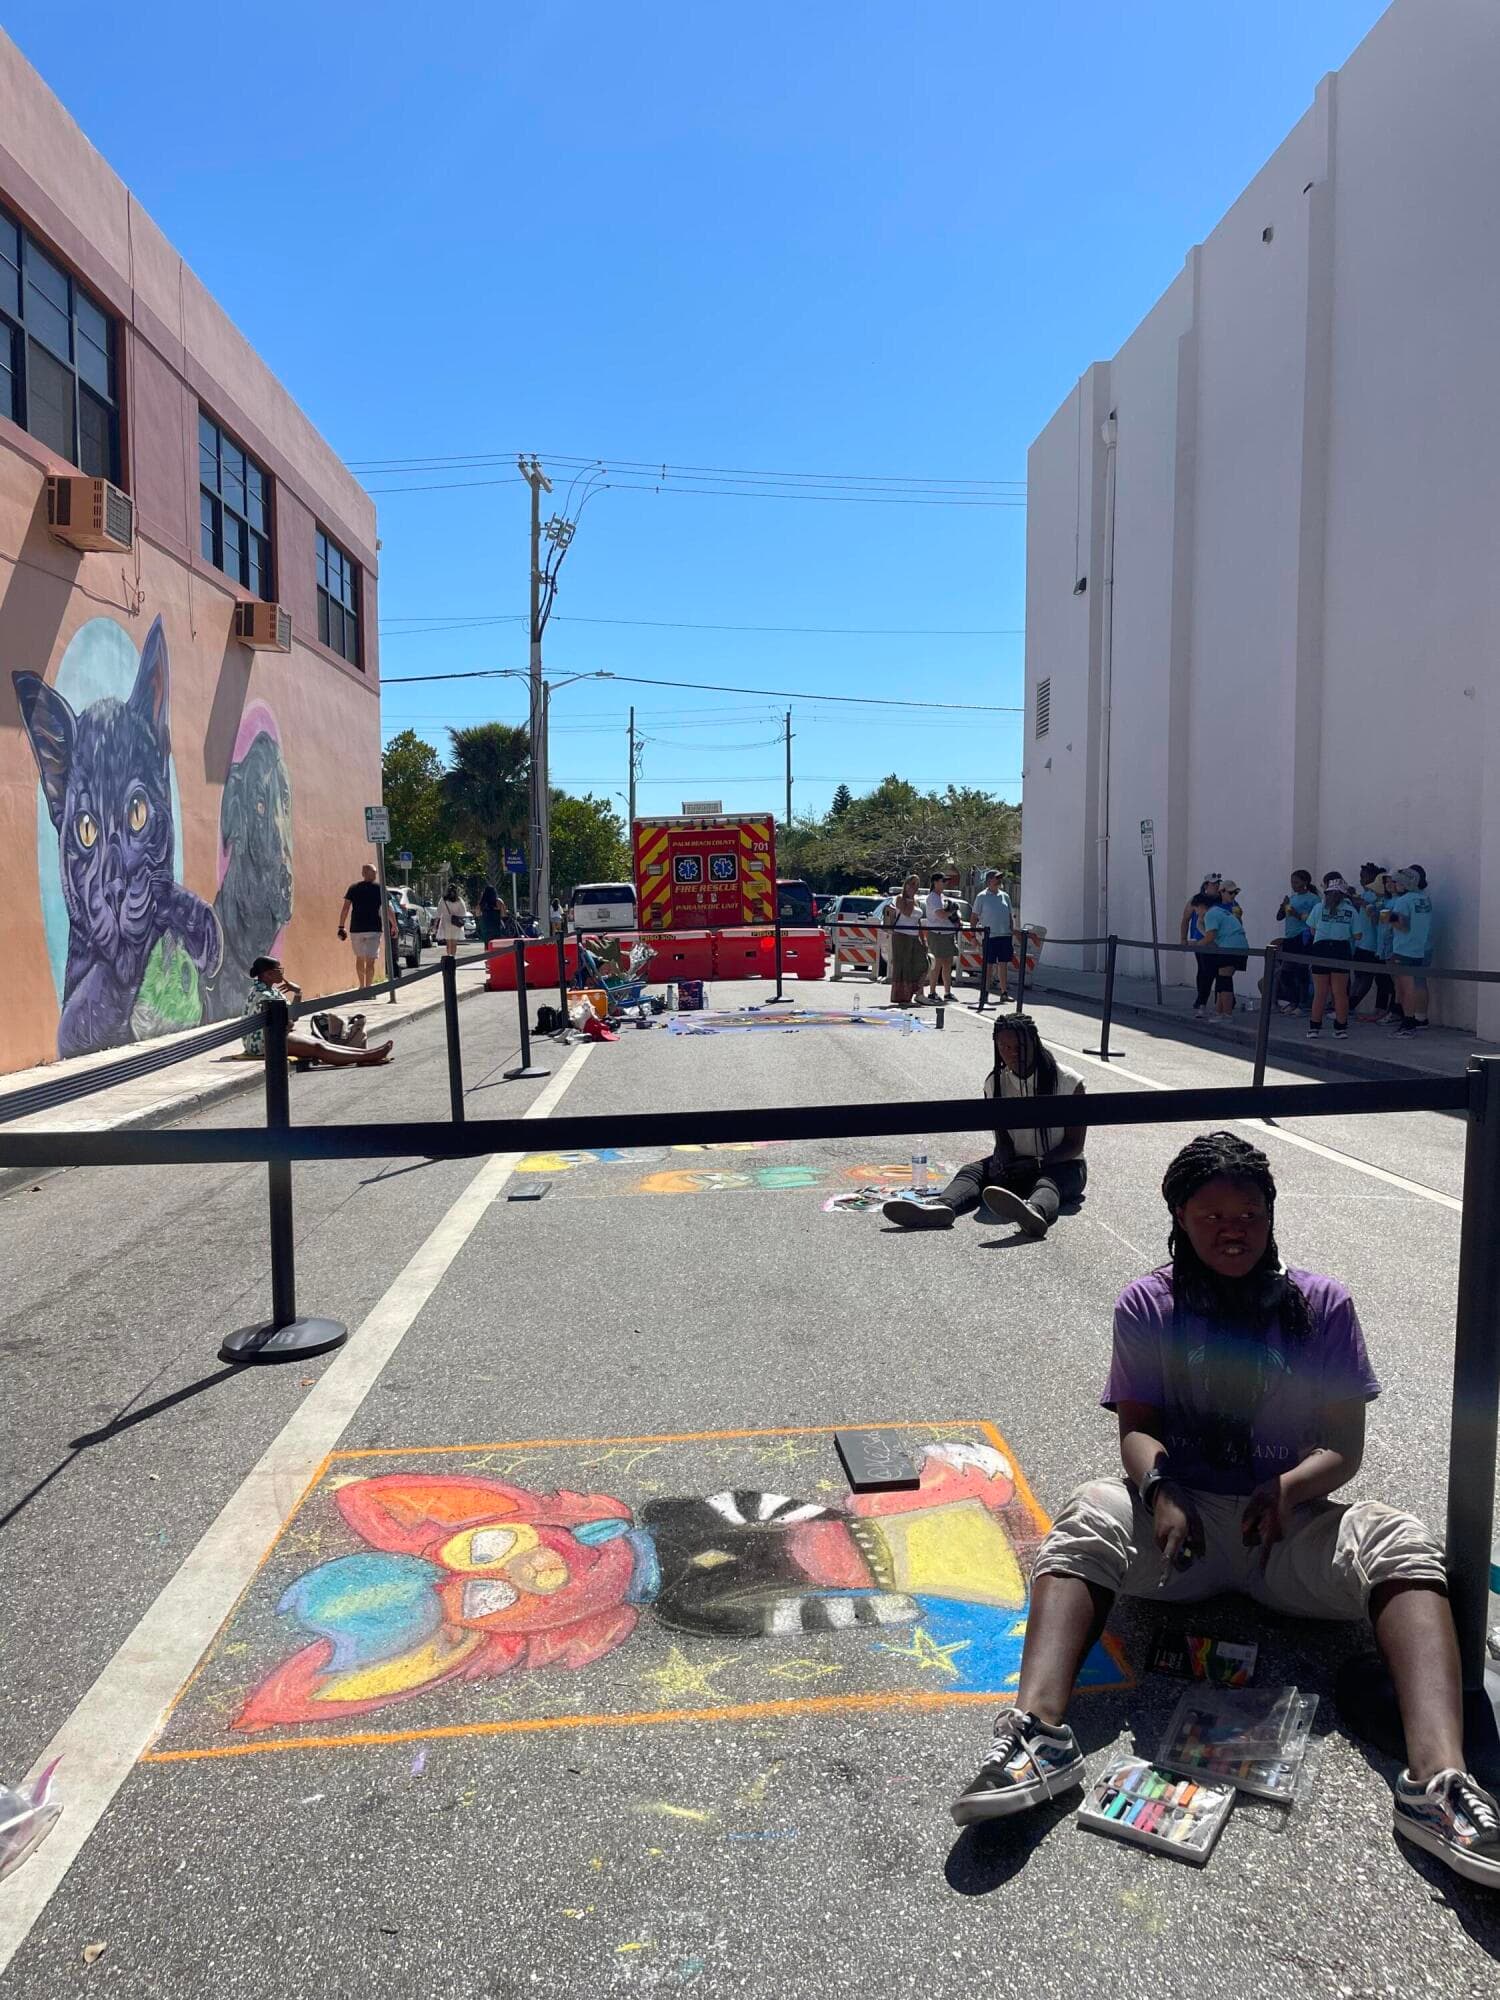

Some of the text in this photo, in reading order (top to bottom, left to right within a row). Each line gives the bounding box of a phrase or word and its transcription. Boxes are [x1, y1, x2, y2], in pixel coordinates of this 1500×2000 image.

[753, 842, 769, 851] 701
[674, 884, 697, 893] FIRE
[699, 883, 738, 892] RESCUE
[675, 902, 739, 911] PARAMEDIC UNIT
